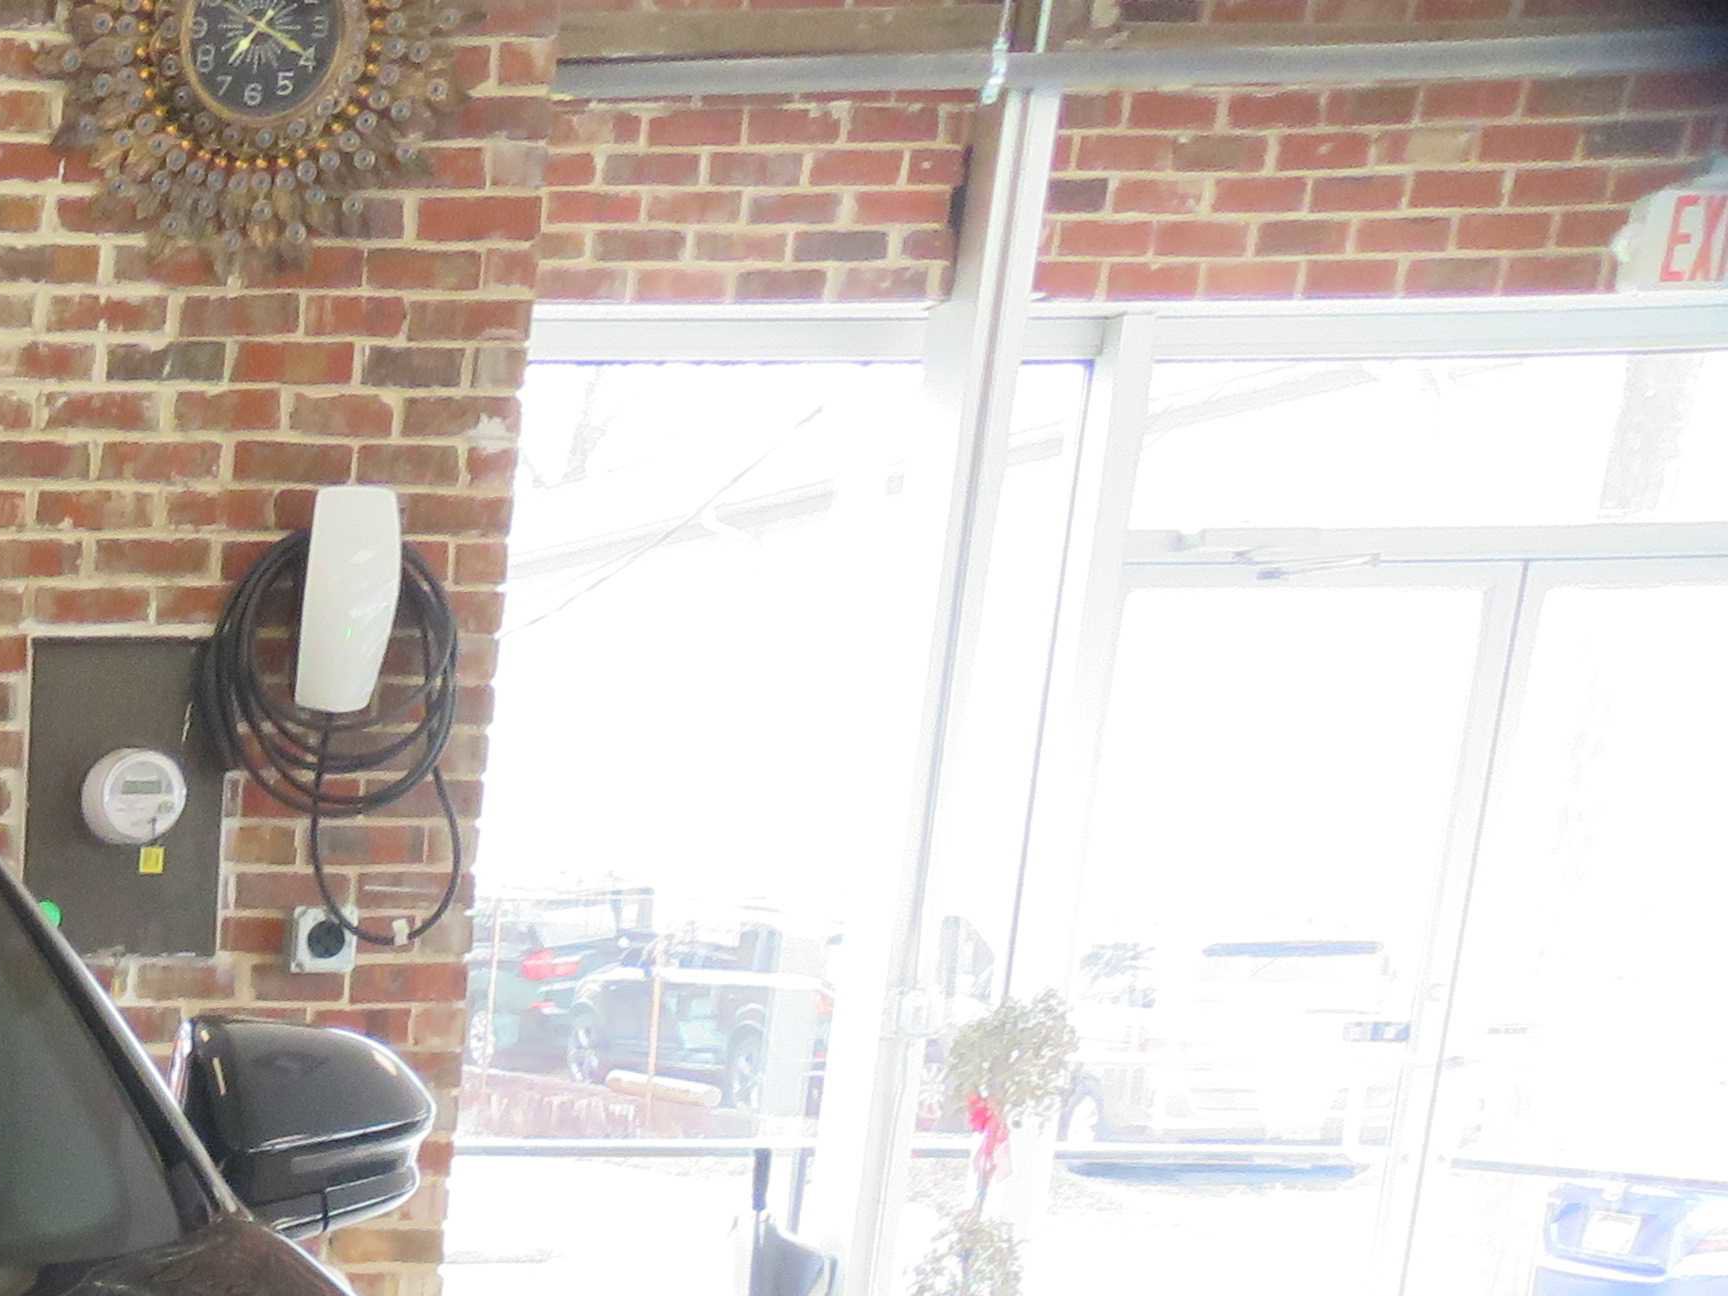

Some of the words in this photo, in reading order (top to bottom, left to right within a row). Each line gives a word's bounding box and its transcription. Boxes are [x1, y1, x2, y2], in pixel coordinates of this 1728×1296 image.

[312, 16, 329, 38] 3
[197, 44, 215, 72] 8
[299, 44, 316, 73] 4
[217, 75, 232, 96] 7
[243, 82, 263, 106] 6
[276, 71, 294, 96] 5
